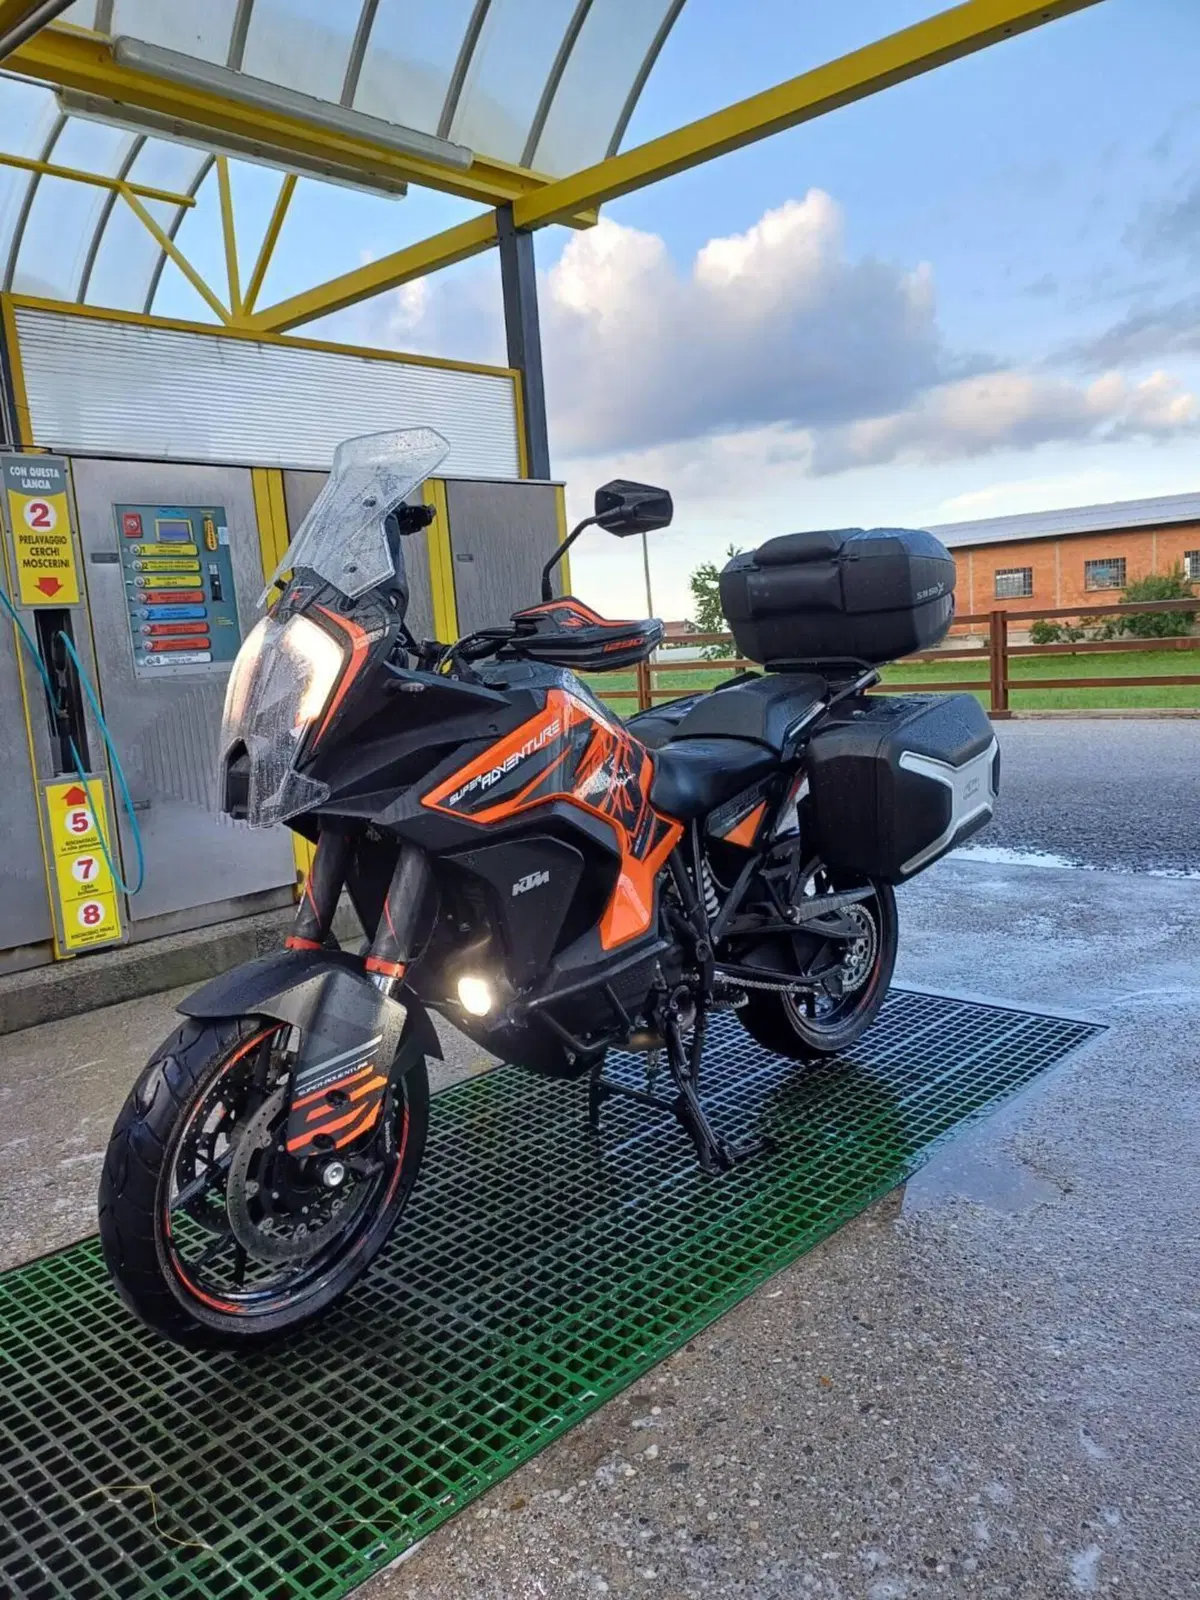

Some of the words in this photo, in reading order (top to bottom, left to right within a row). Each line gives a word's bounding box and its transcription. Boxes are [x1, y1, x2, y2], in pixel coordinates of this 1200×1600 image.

[10, 466, 28, 477] CON
[29, 467, 60, 479] QUESTA
[22, 478, 51, 490] LANCIA
[30, 503, 51, 527] 2
[19, 535, 68, 546] PRELAVAGGIO
[29, 547, 60, 557] CERCHI
[22, 559, 70, 569] MOSCERINI
[449, 774, 482, 806] SUPER
[481, 718, 561, 790] ADVENTURE
[71, 811, 89, 833] 5
[77, 858, 94, 880] 7
[511, 870, 550, 897] KTM
[83, 904, 100, 925] 8
